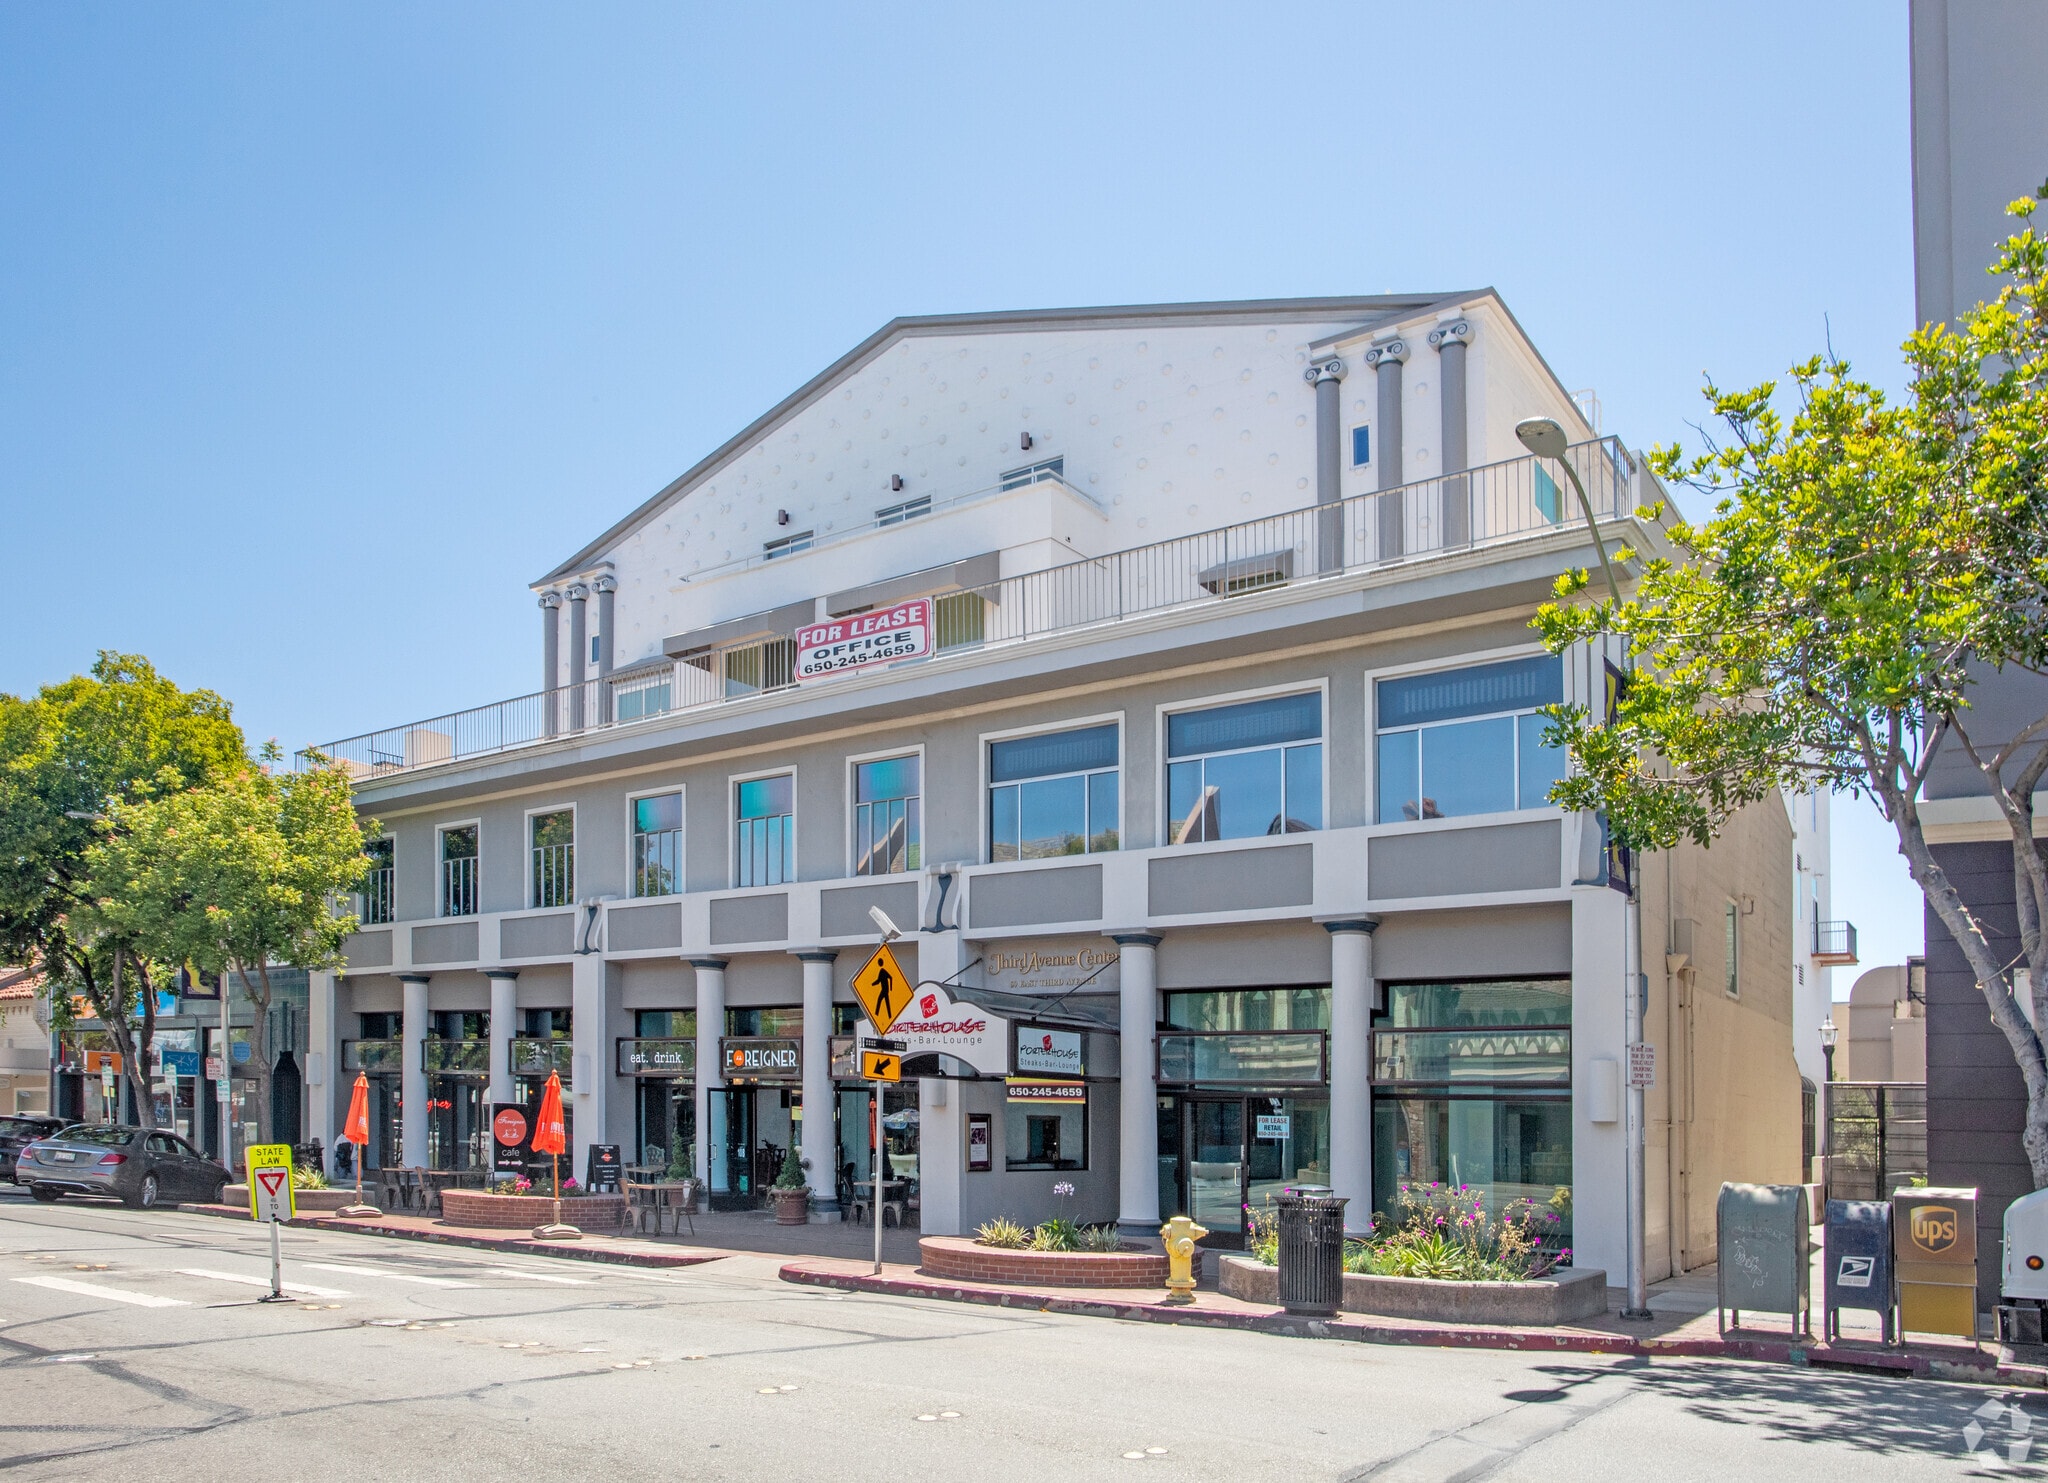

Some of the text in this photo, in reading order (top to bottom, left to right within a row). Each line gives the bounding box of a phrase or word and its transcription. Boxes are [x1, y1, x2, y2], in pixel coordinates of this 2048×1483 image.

[801, 606, 922, 647] FOR LEASE
[813, 631, 912, 659] OFFICE
[804, 643, 916, 674] 650-245-4659
[988, 947, 1120, 975] Third Avenue Center
[1040, 978, 1063, 987] THIRD
[630, 1051, 684, 1064] eat. drink.
[726, 1050, 796, 1067] FOREIGNER
[1020, 1044, 1079, 1059] PORTERHOUSE
[167, 1054, 198, 1067] SKY
[1009, 1087, 1083, 1096] 650-245-4659
[256, 1148, 284, 1156] STATE
[502, 1148, 520, 1157] cafe
[1914, 1220, 1954, 1247] ups
